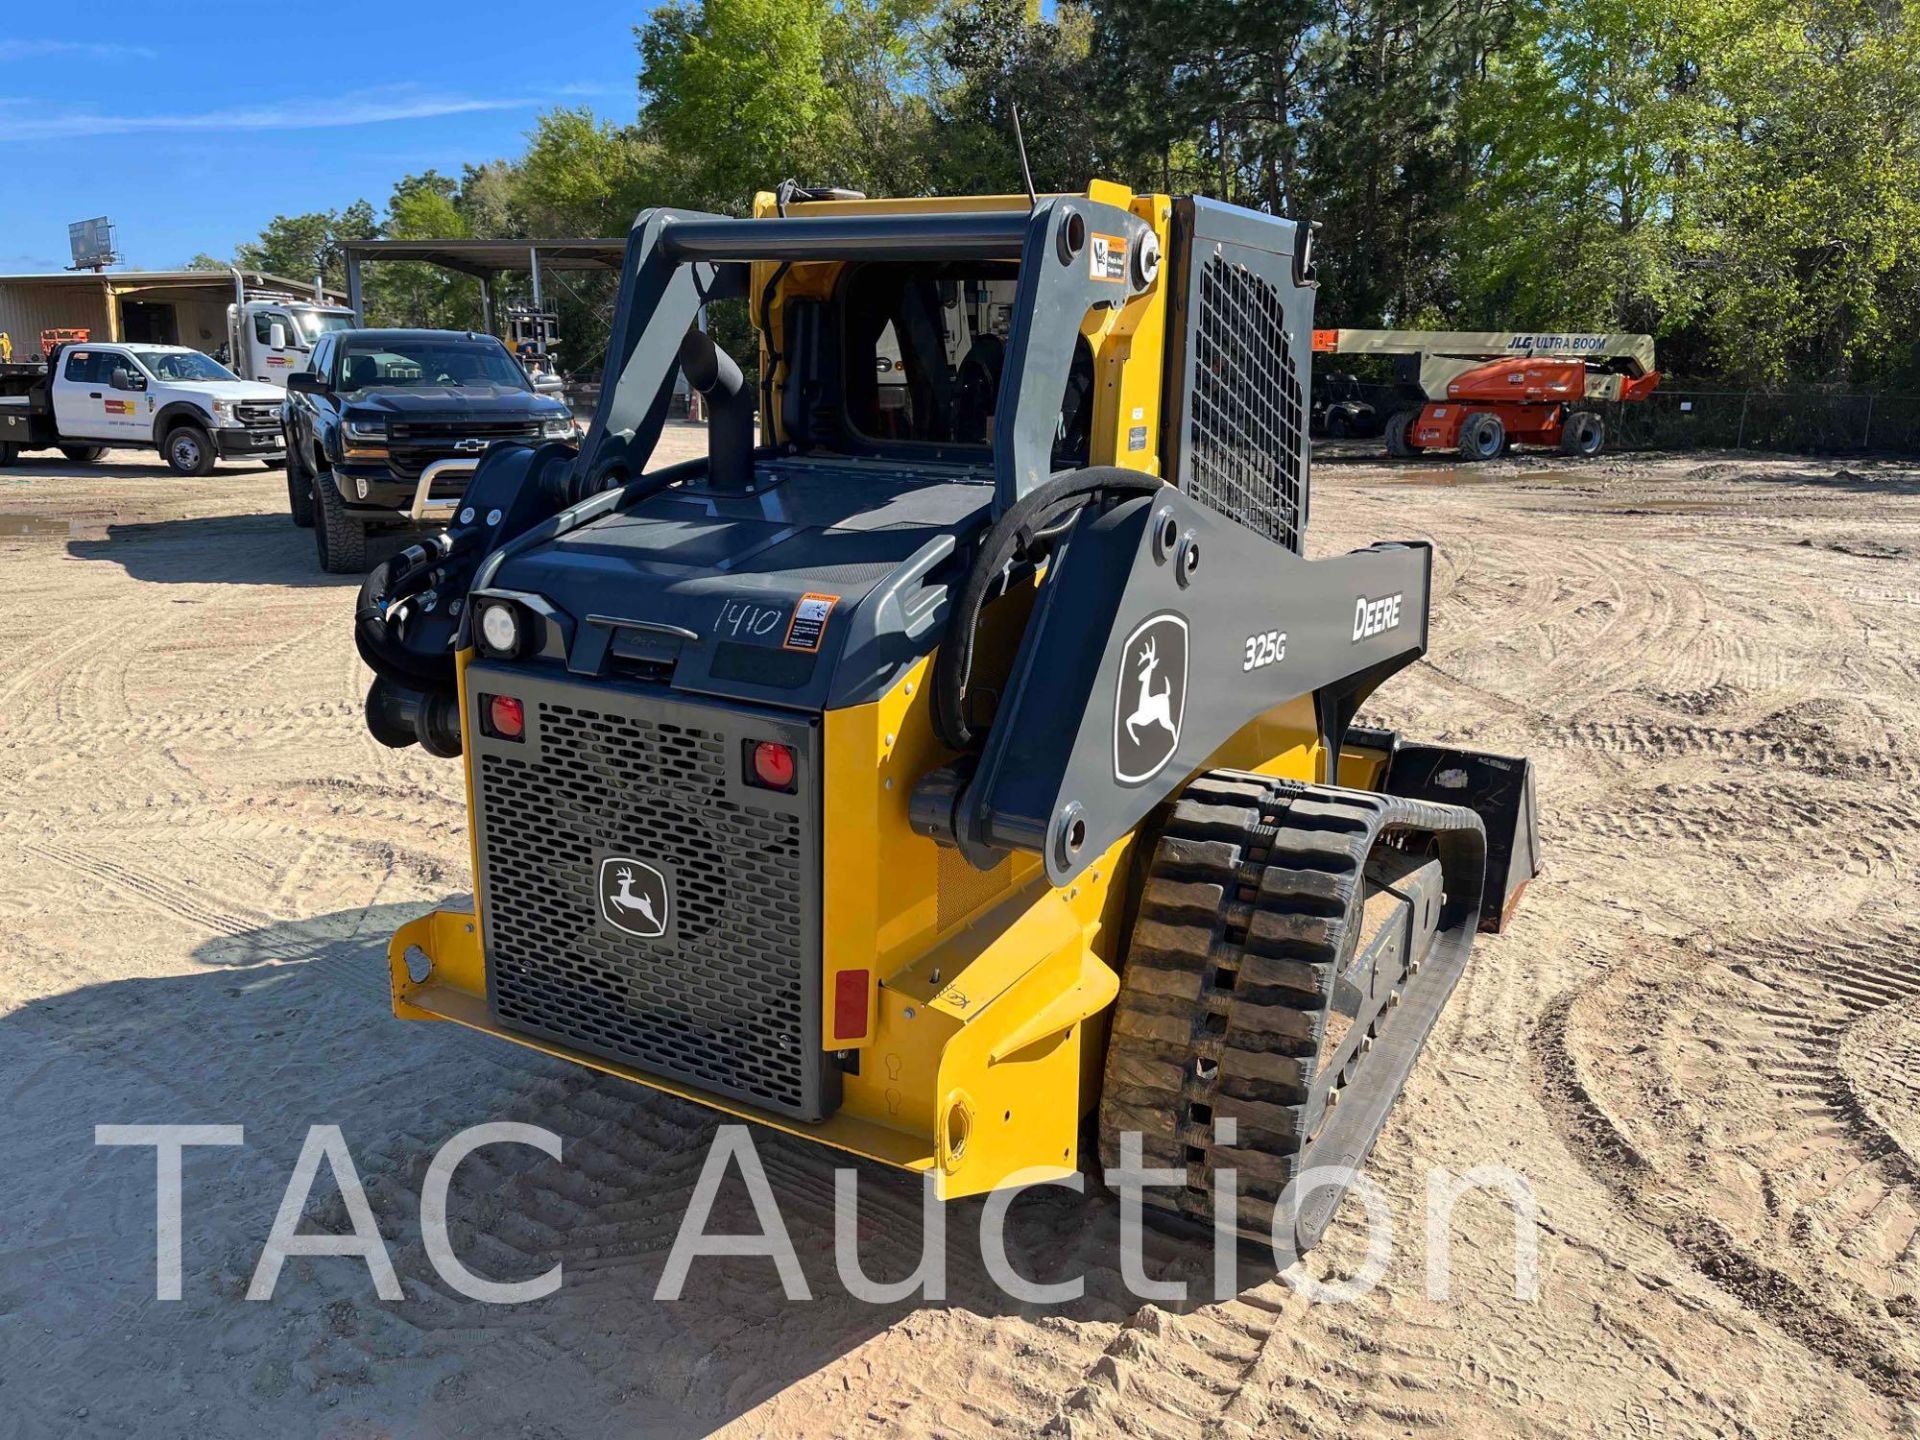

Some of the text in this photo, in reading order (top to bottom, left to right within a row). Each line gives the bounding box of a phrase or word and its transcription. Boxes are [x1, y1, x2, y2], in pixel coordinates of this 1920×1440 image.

[1508, 336, 1606, 349] JLG ULTRA BOOM
[1352, 594, 1403, 641] DEERE
[1243, 630, 1288, 672] 325G
